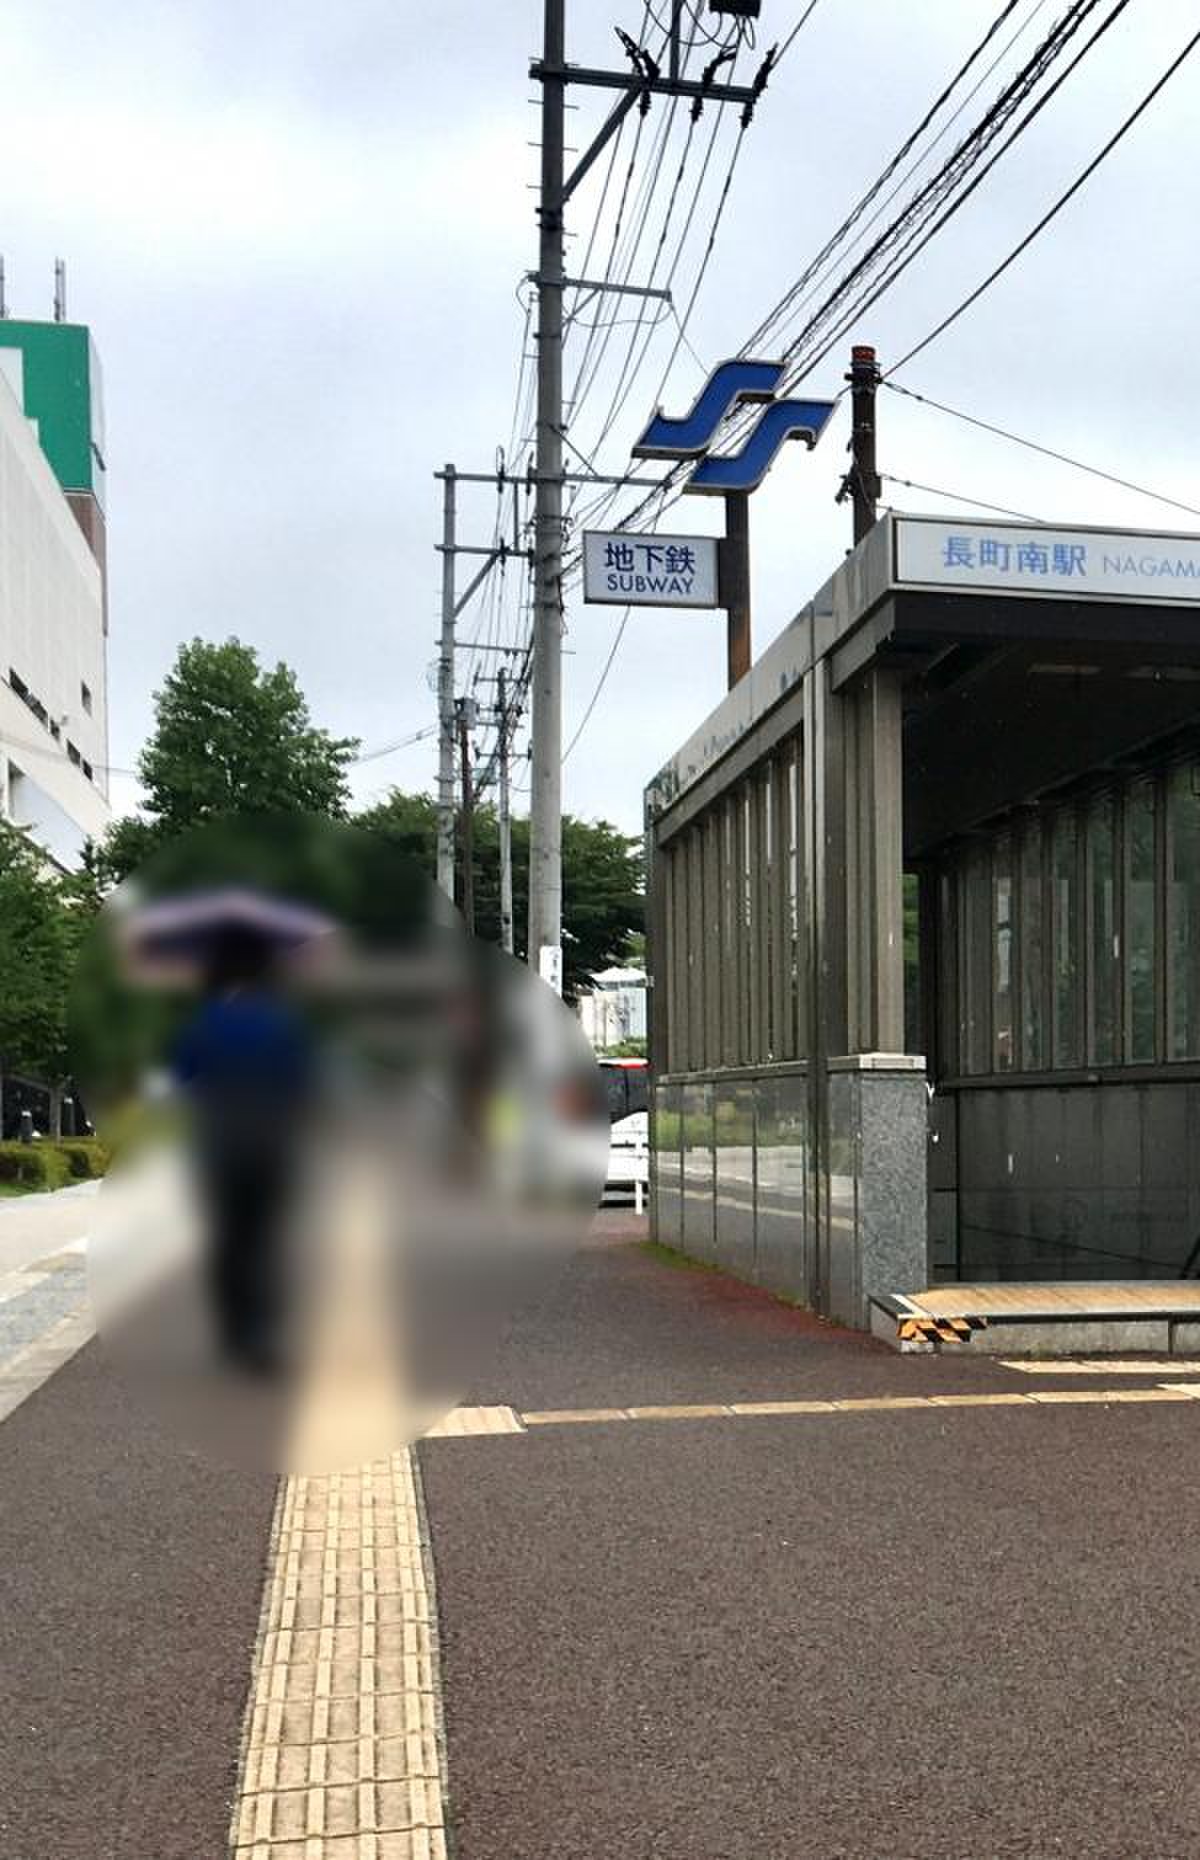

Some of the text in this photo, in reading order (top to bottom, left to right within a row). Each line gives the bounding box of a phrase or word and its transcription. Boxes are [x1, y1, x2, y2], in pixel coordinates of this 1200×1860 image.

[604, 541, 696, 575] 地下鉄
[943, 536, 1087, 577] 長町南駅
[607, 574, 694, 594] SUBWAY
